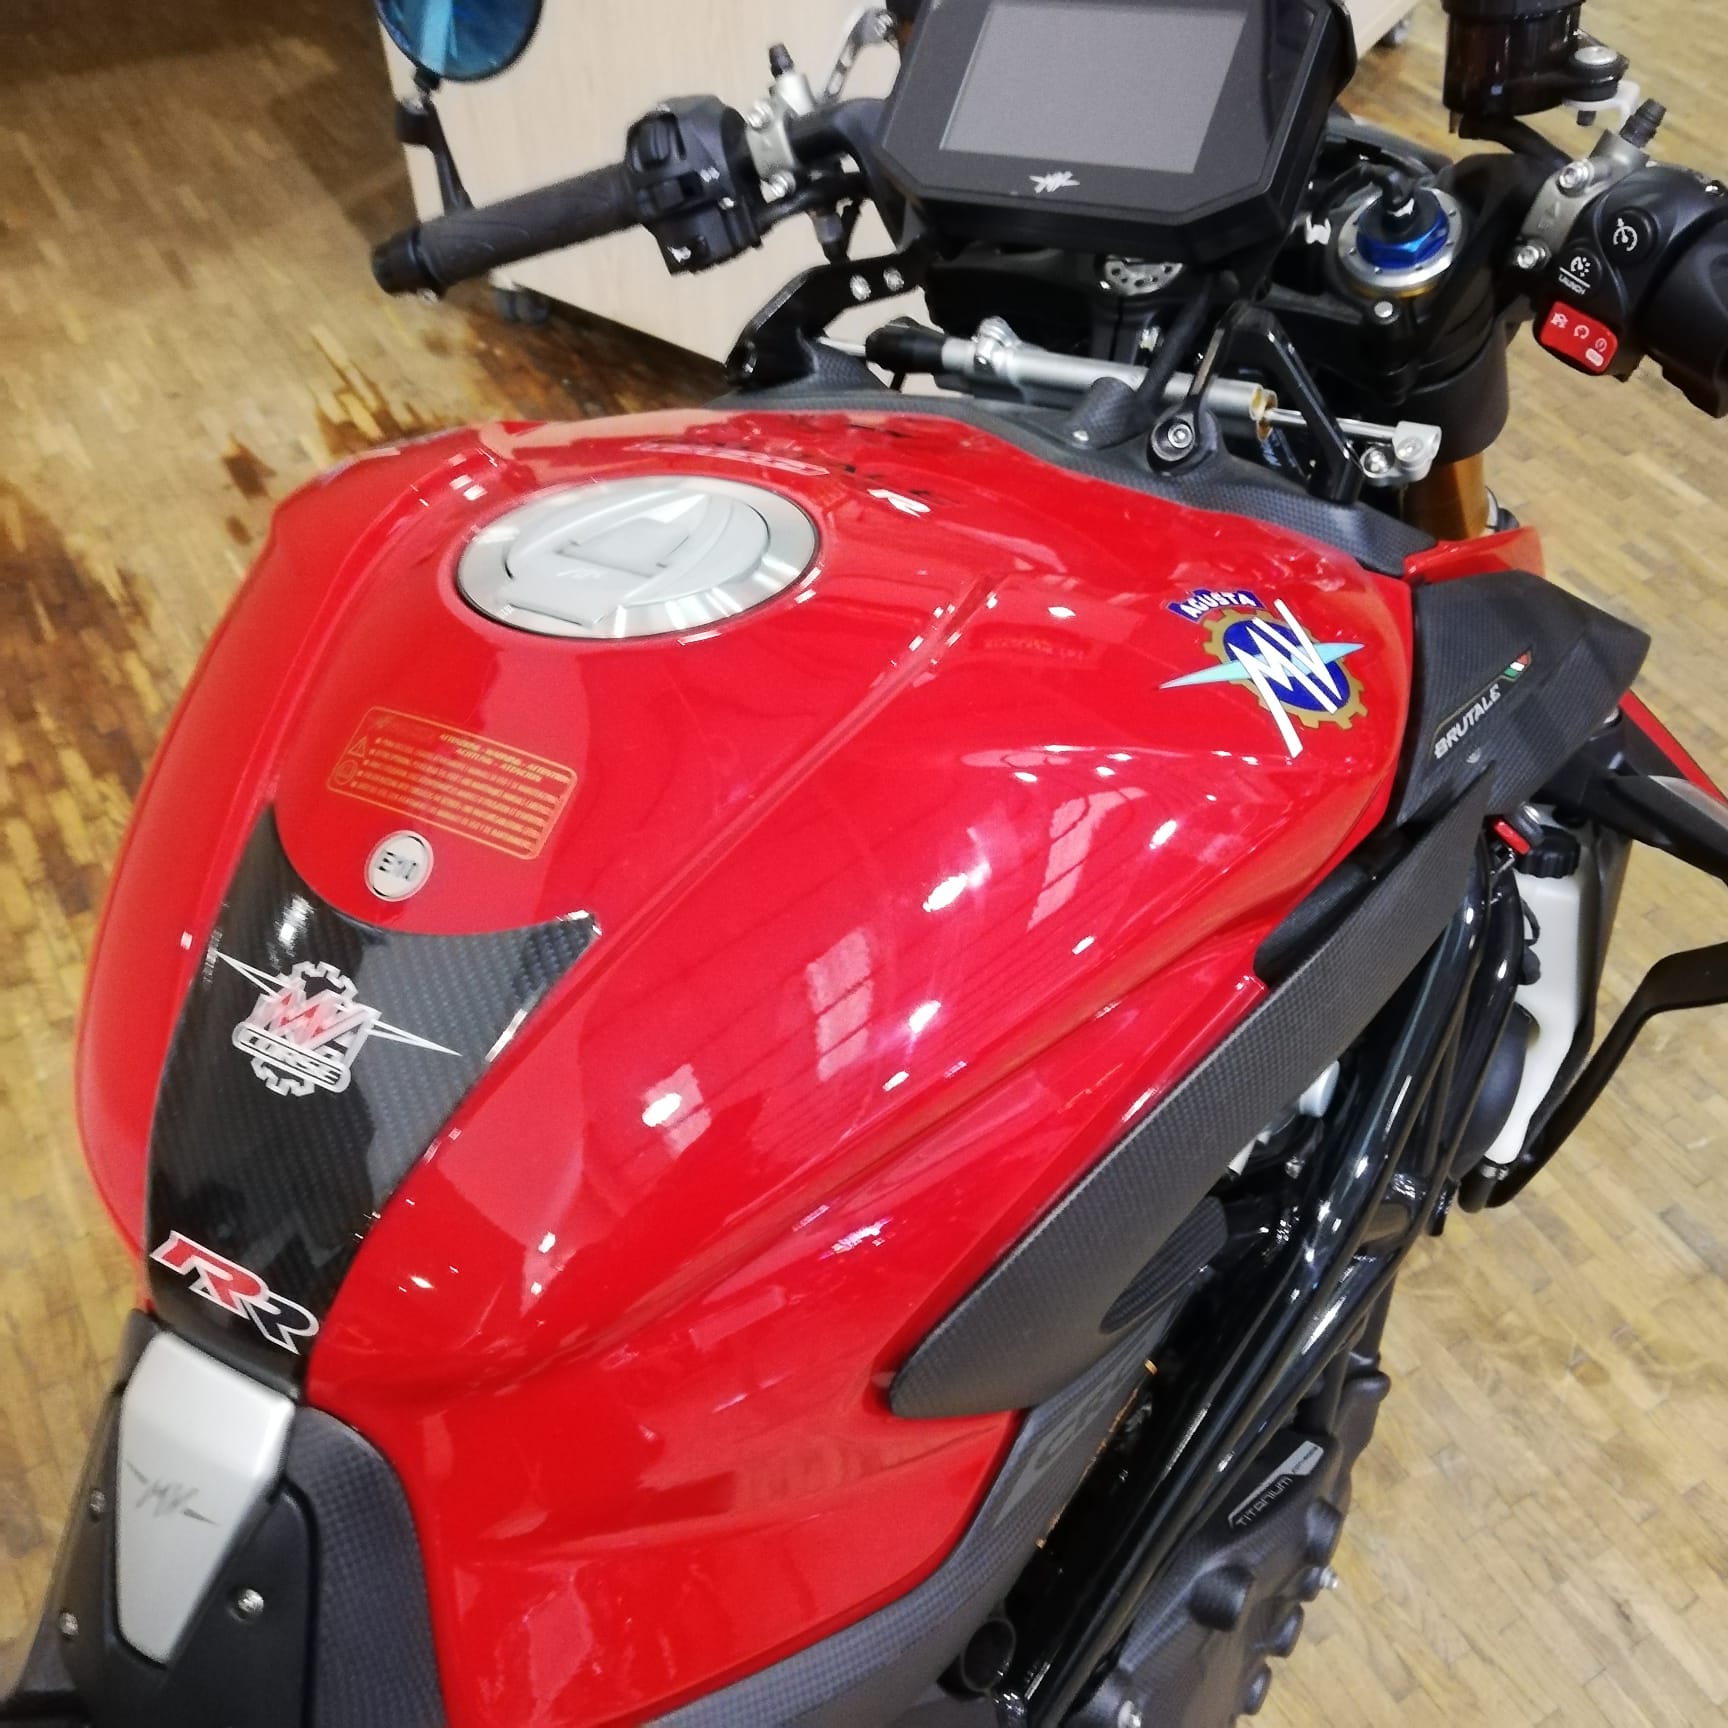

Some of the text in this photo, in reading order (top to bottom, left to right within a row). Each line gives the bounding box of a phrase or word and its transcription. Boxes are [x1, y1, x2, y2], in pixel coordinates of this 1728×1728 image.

[1180, 591, 1257, 619] AGUSTA
[1227, 598, 1343, 759] MV
[1434, 683, 1502, 759] BRUTALE
[150, 1230, 320, 1356] RR
